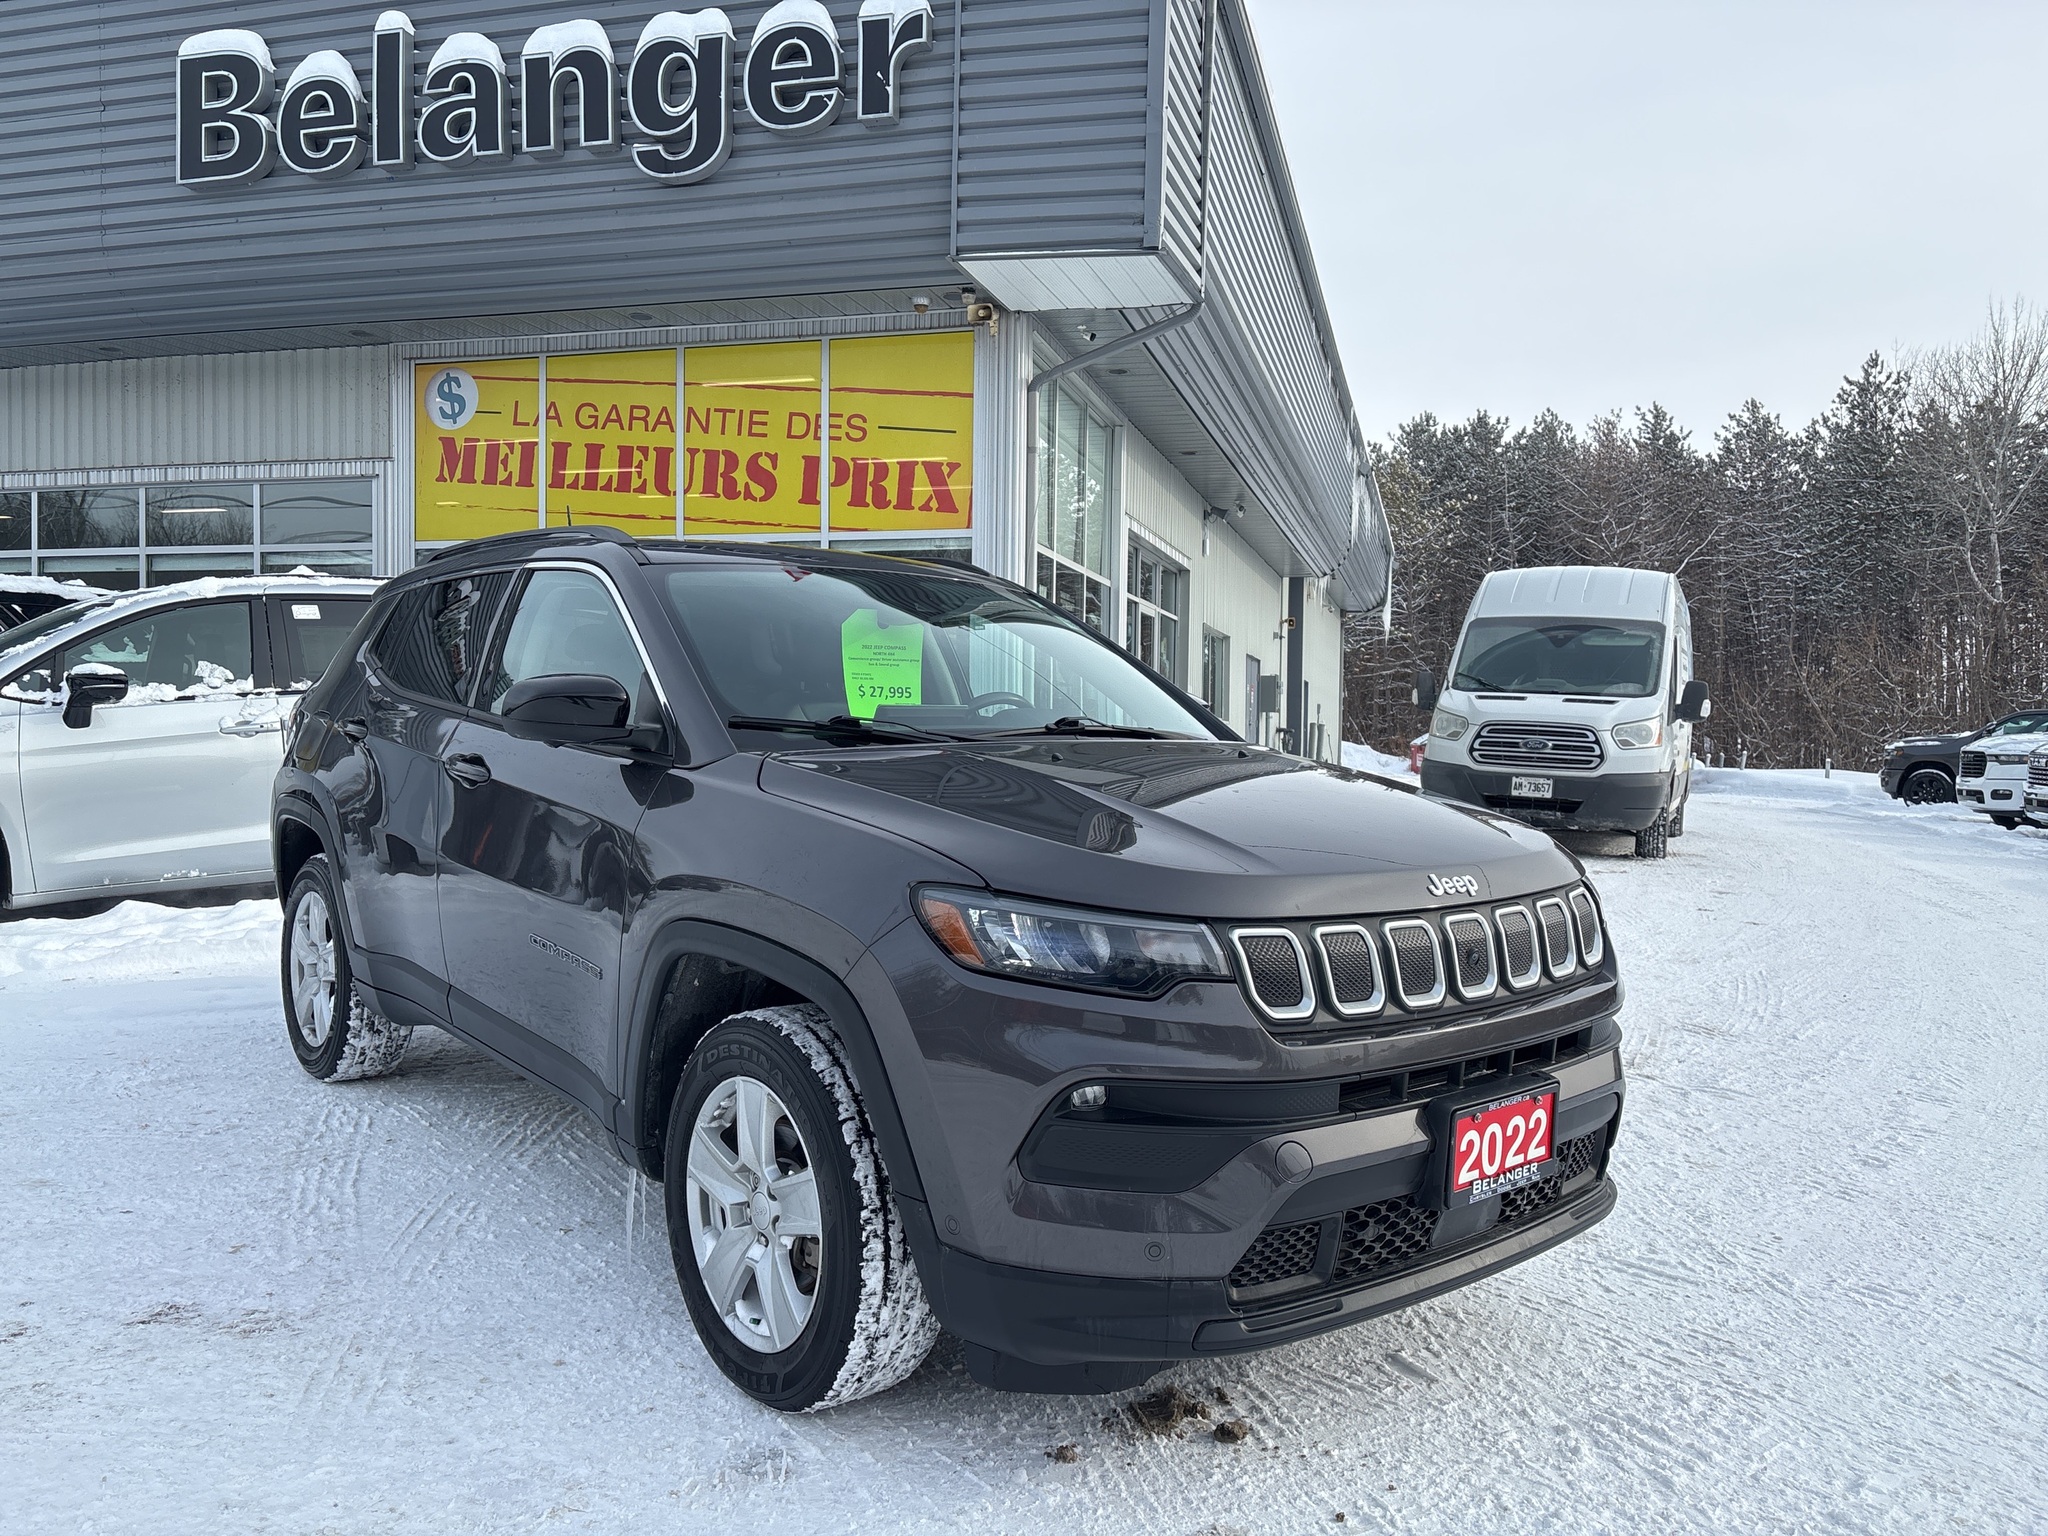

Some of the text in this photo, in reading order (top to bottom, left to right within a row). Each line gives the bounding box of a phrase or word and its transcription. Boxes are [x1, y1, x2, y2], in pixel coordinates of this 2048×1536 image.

[176, 6, 931, 183] Belanger
[513, 400, 868, 442] LA GARANTIE DES
[436, 436, 961, 513] MEILLEURS PRIX
[858, 684, 912, 701] $ 27,995
[1527, 782, 1551, 793] 73657
[1426, 873, 1479, 897] Jeep
[529, 933, 604, 980] COMPASS
[1458, 1108, 1548, 1186] 2022
[1472, 1162, 1538, 1195] BELANGER
